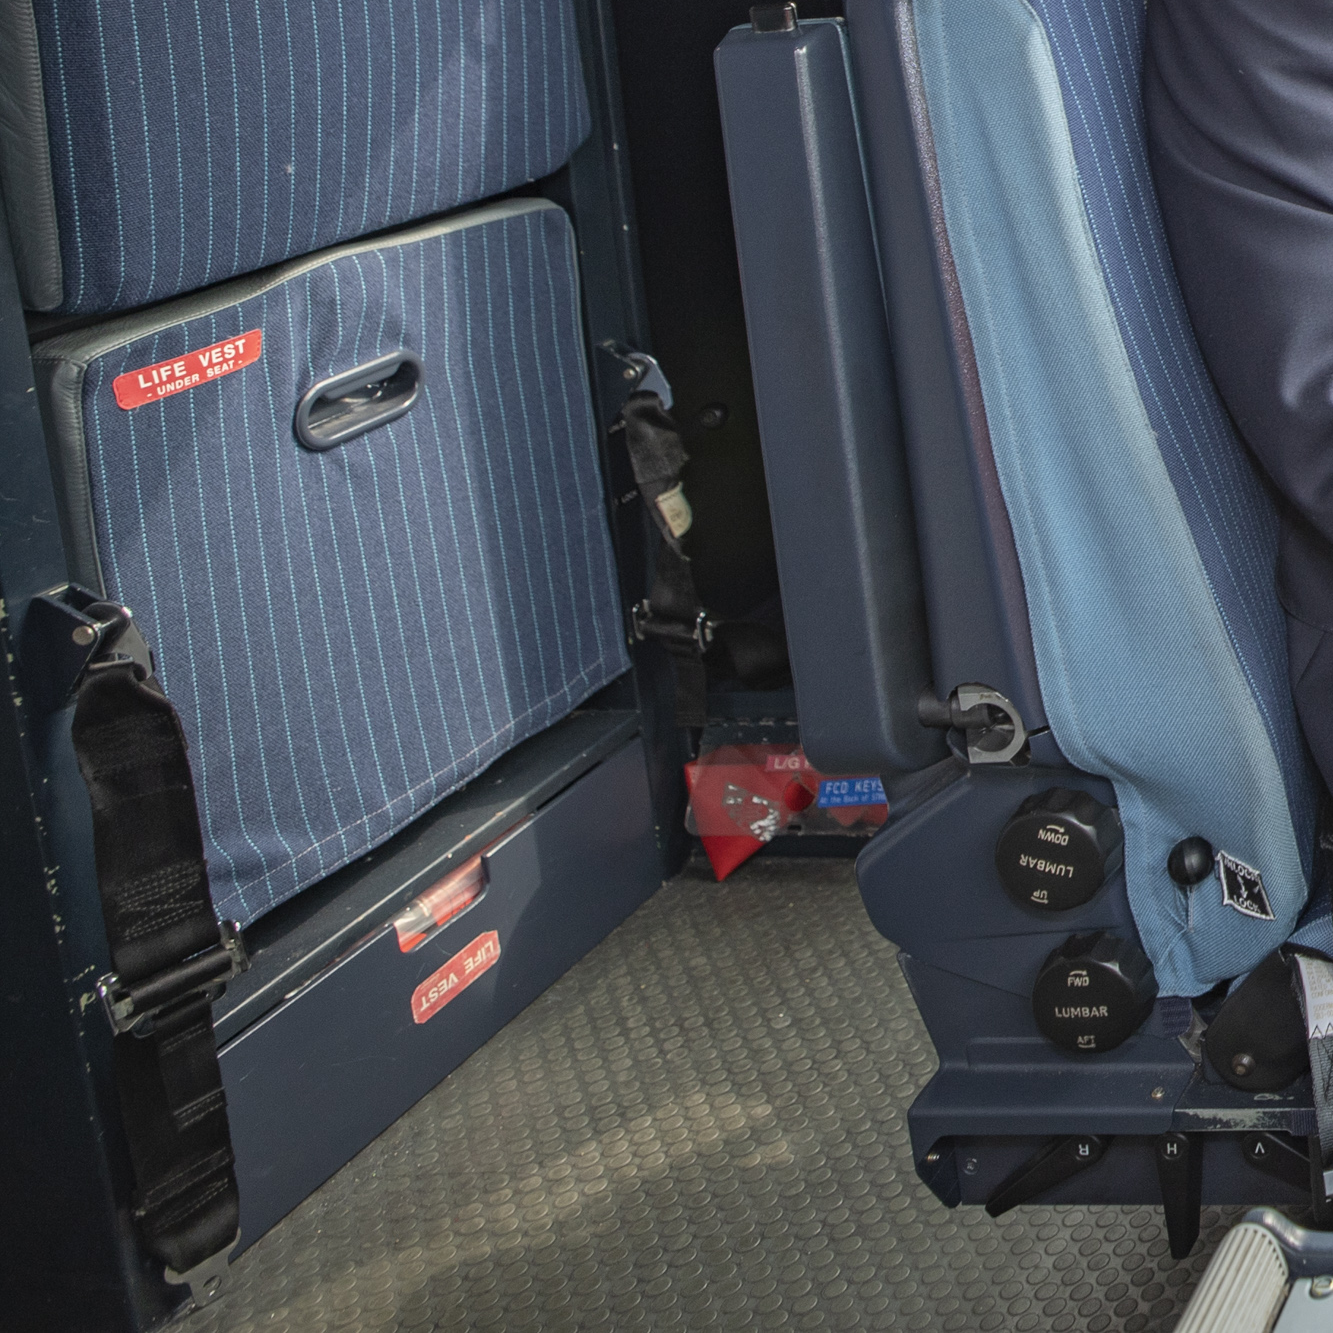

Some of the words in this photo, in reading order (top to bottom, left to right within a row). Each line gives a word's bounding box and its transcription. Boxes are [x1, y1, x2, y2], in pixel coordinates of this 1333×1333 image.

[138, 361, 186, 389] LIFE
[198, 339, 246, 367] VEST
[156, 373, 200, 396] UNDER
[206, 360, 236, 378] SEAT
[773, 757, 800, 770] L/G
[854, 779, 884, 792] KEYS
[1037, 828, 1069, 846] DOWN
[1019, 853, 1074, 878] LUMBAR
[1032, 889, 1048, 899] UP
[463, 940, 494, 974] LIFE
[1067, 976, 1090, 987] FWD
[419, 972, 459, 1011] VEST
[1055, 1005, 1108, 1019] LUMBAR
[1076, 1035, 1096, 1044] AFT
[1078, 1143, 1090, 1156] R
[1166, 1143, 1177, 1155] H
[1254, 1142, 1265, 1155] V
